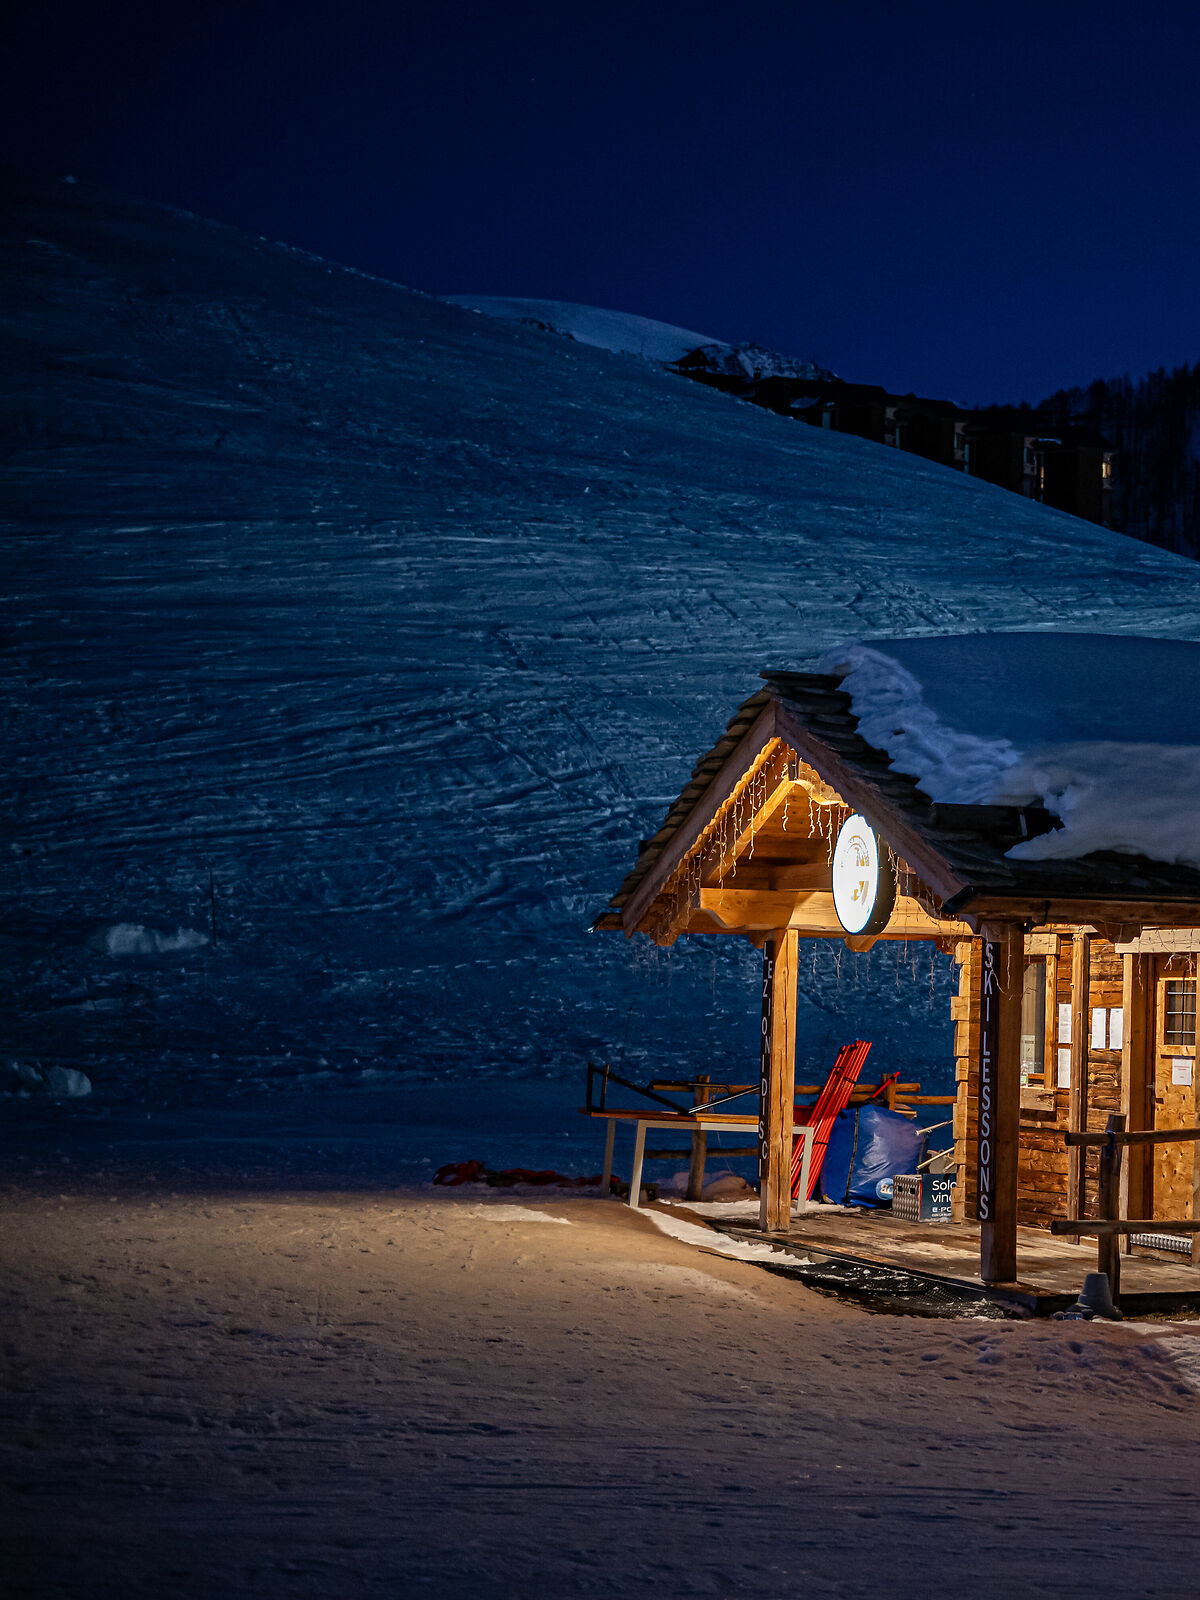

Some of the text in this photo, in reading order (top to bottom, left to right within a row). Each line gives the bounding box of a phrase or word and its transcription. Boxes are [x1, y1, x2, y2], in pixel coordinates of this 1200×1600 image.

[762, 942, 773, 1073] LEZIONI
[979, 943, 993, 1220] SKI LESSONS
[931, 1192, 952, 1203] vin
